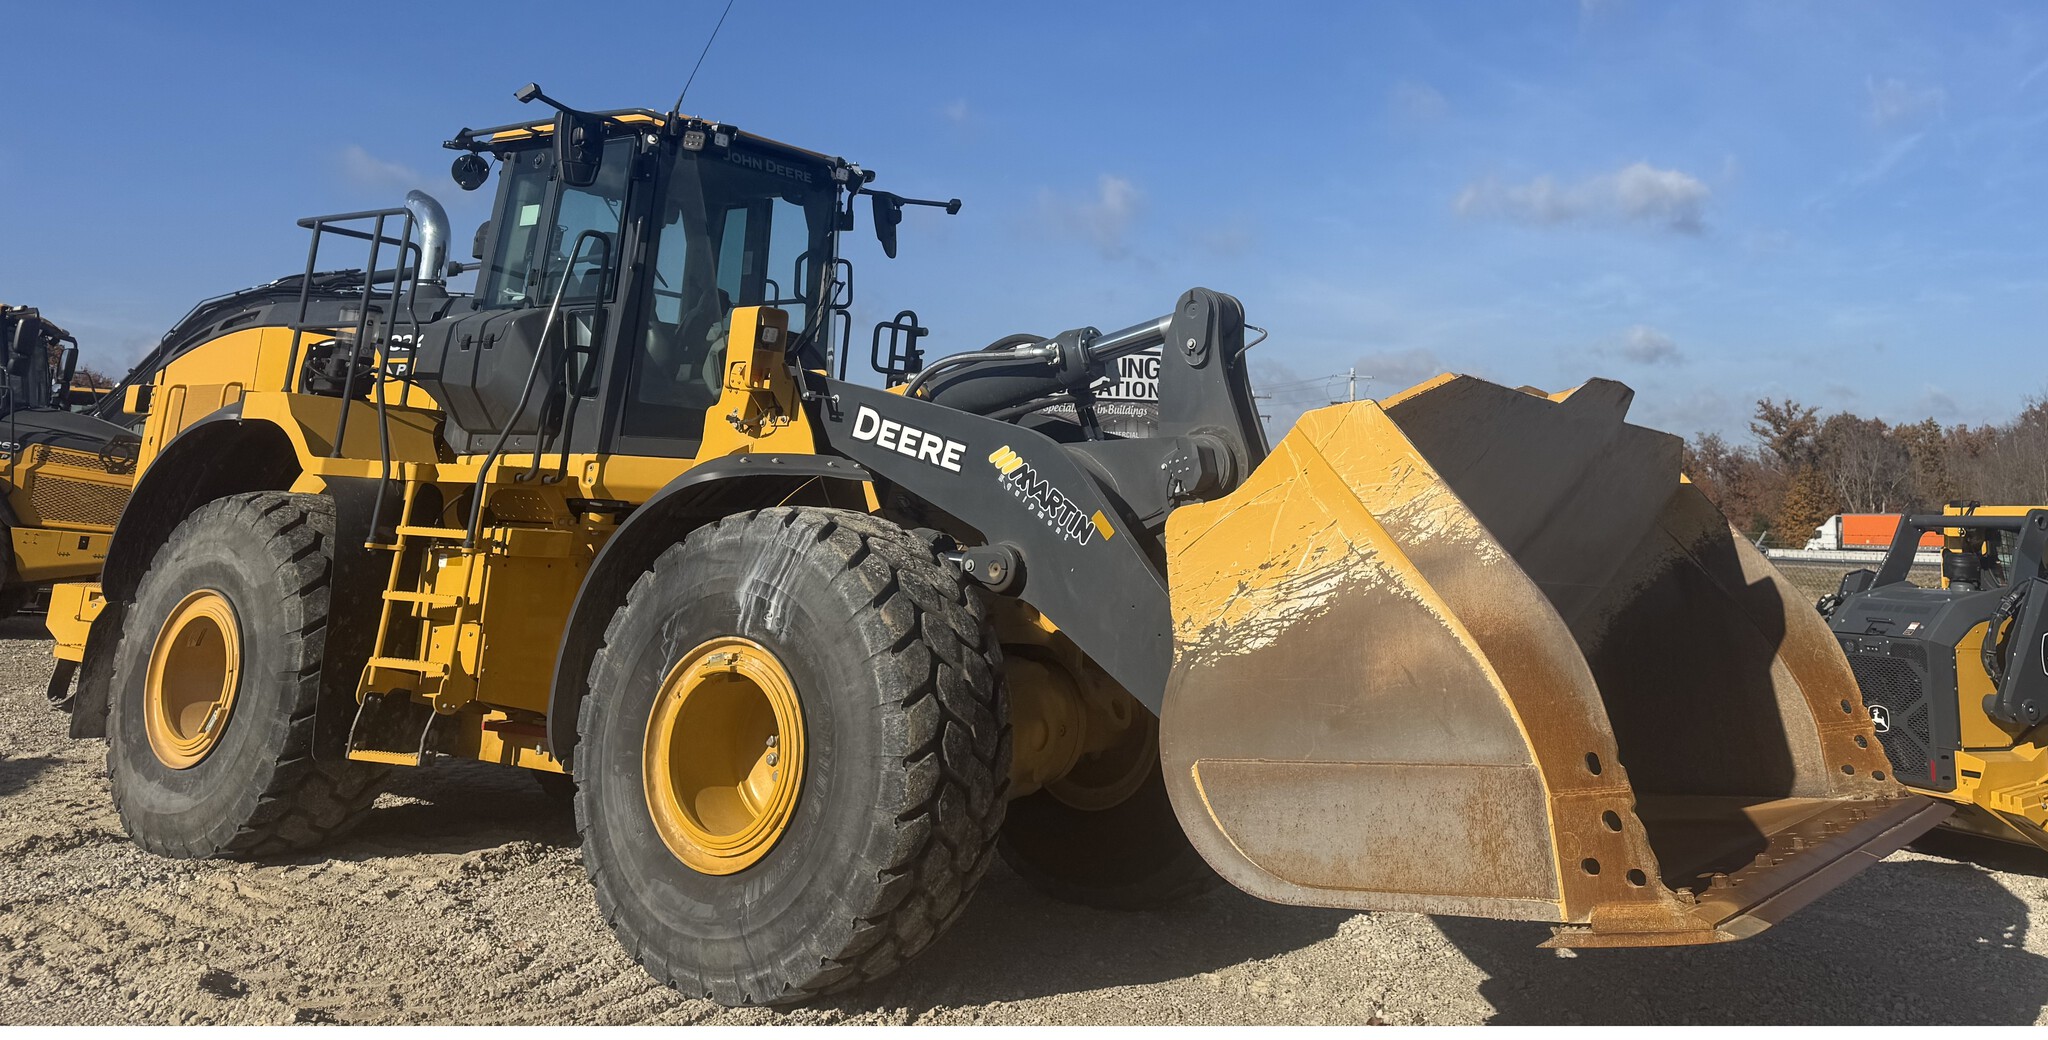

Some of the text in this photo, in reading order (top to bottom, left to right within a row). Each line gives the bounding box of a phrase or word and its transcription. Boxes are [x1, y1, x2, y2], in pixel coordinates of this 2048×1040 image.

[723, 147, 813, 183] JOHN DEERE
[1121, 357, 1160, 379] ING
[1096, 380, 1159, 398] ATION
[1108, 403, 1148, 418] Buildings
[0, 441, 21, 451] 60
[852, 405, 967, 473] DEERE
[1007, 462, 1096, 546] MARTIN
